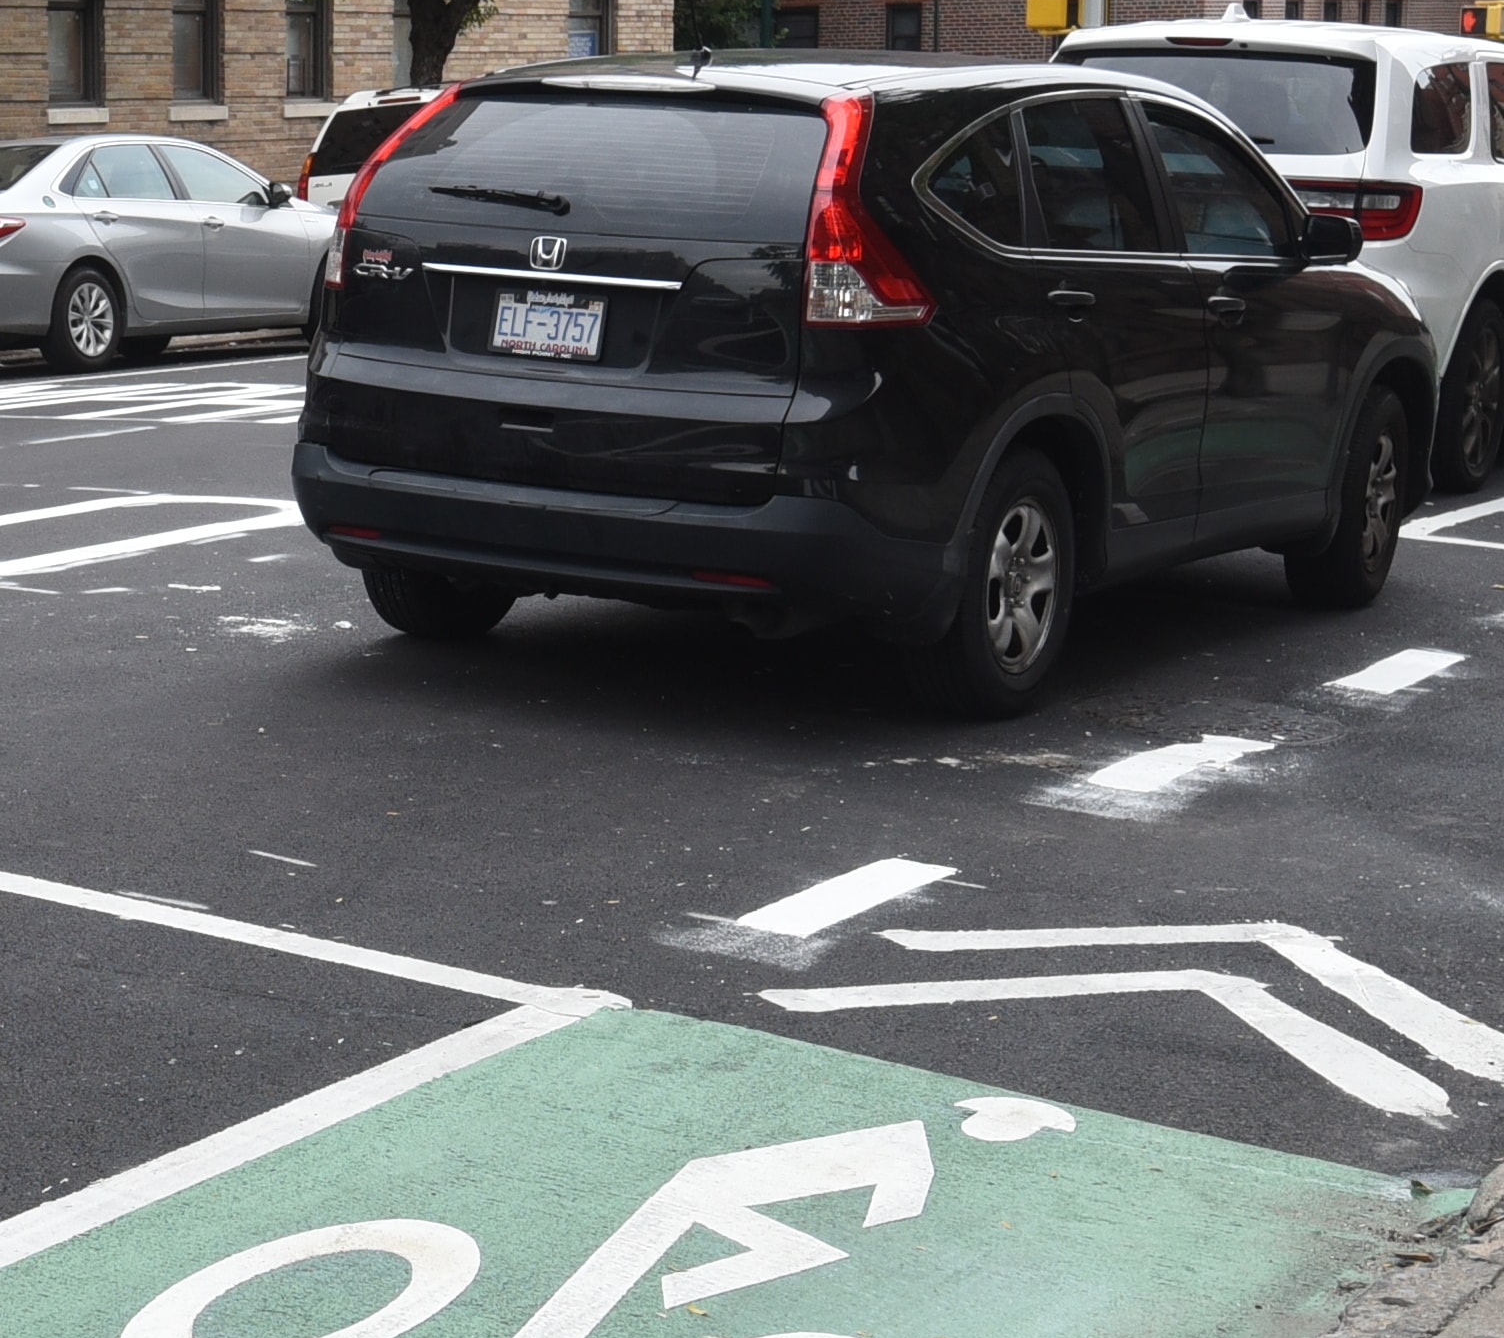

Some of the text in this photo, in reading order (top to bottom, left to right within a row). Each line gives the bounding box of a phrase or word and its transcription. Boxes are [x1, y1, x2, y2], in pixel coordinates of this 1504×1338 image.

[353, 263, 414, 280] CR-V
[498, 306, 599, 343] ELF-3757
[501, 339, 589, 356] NORTH CAROLINA
